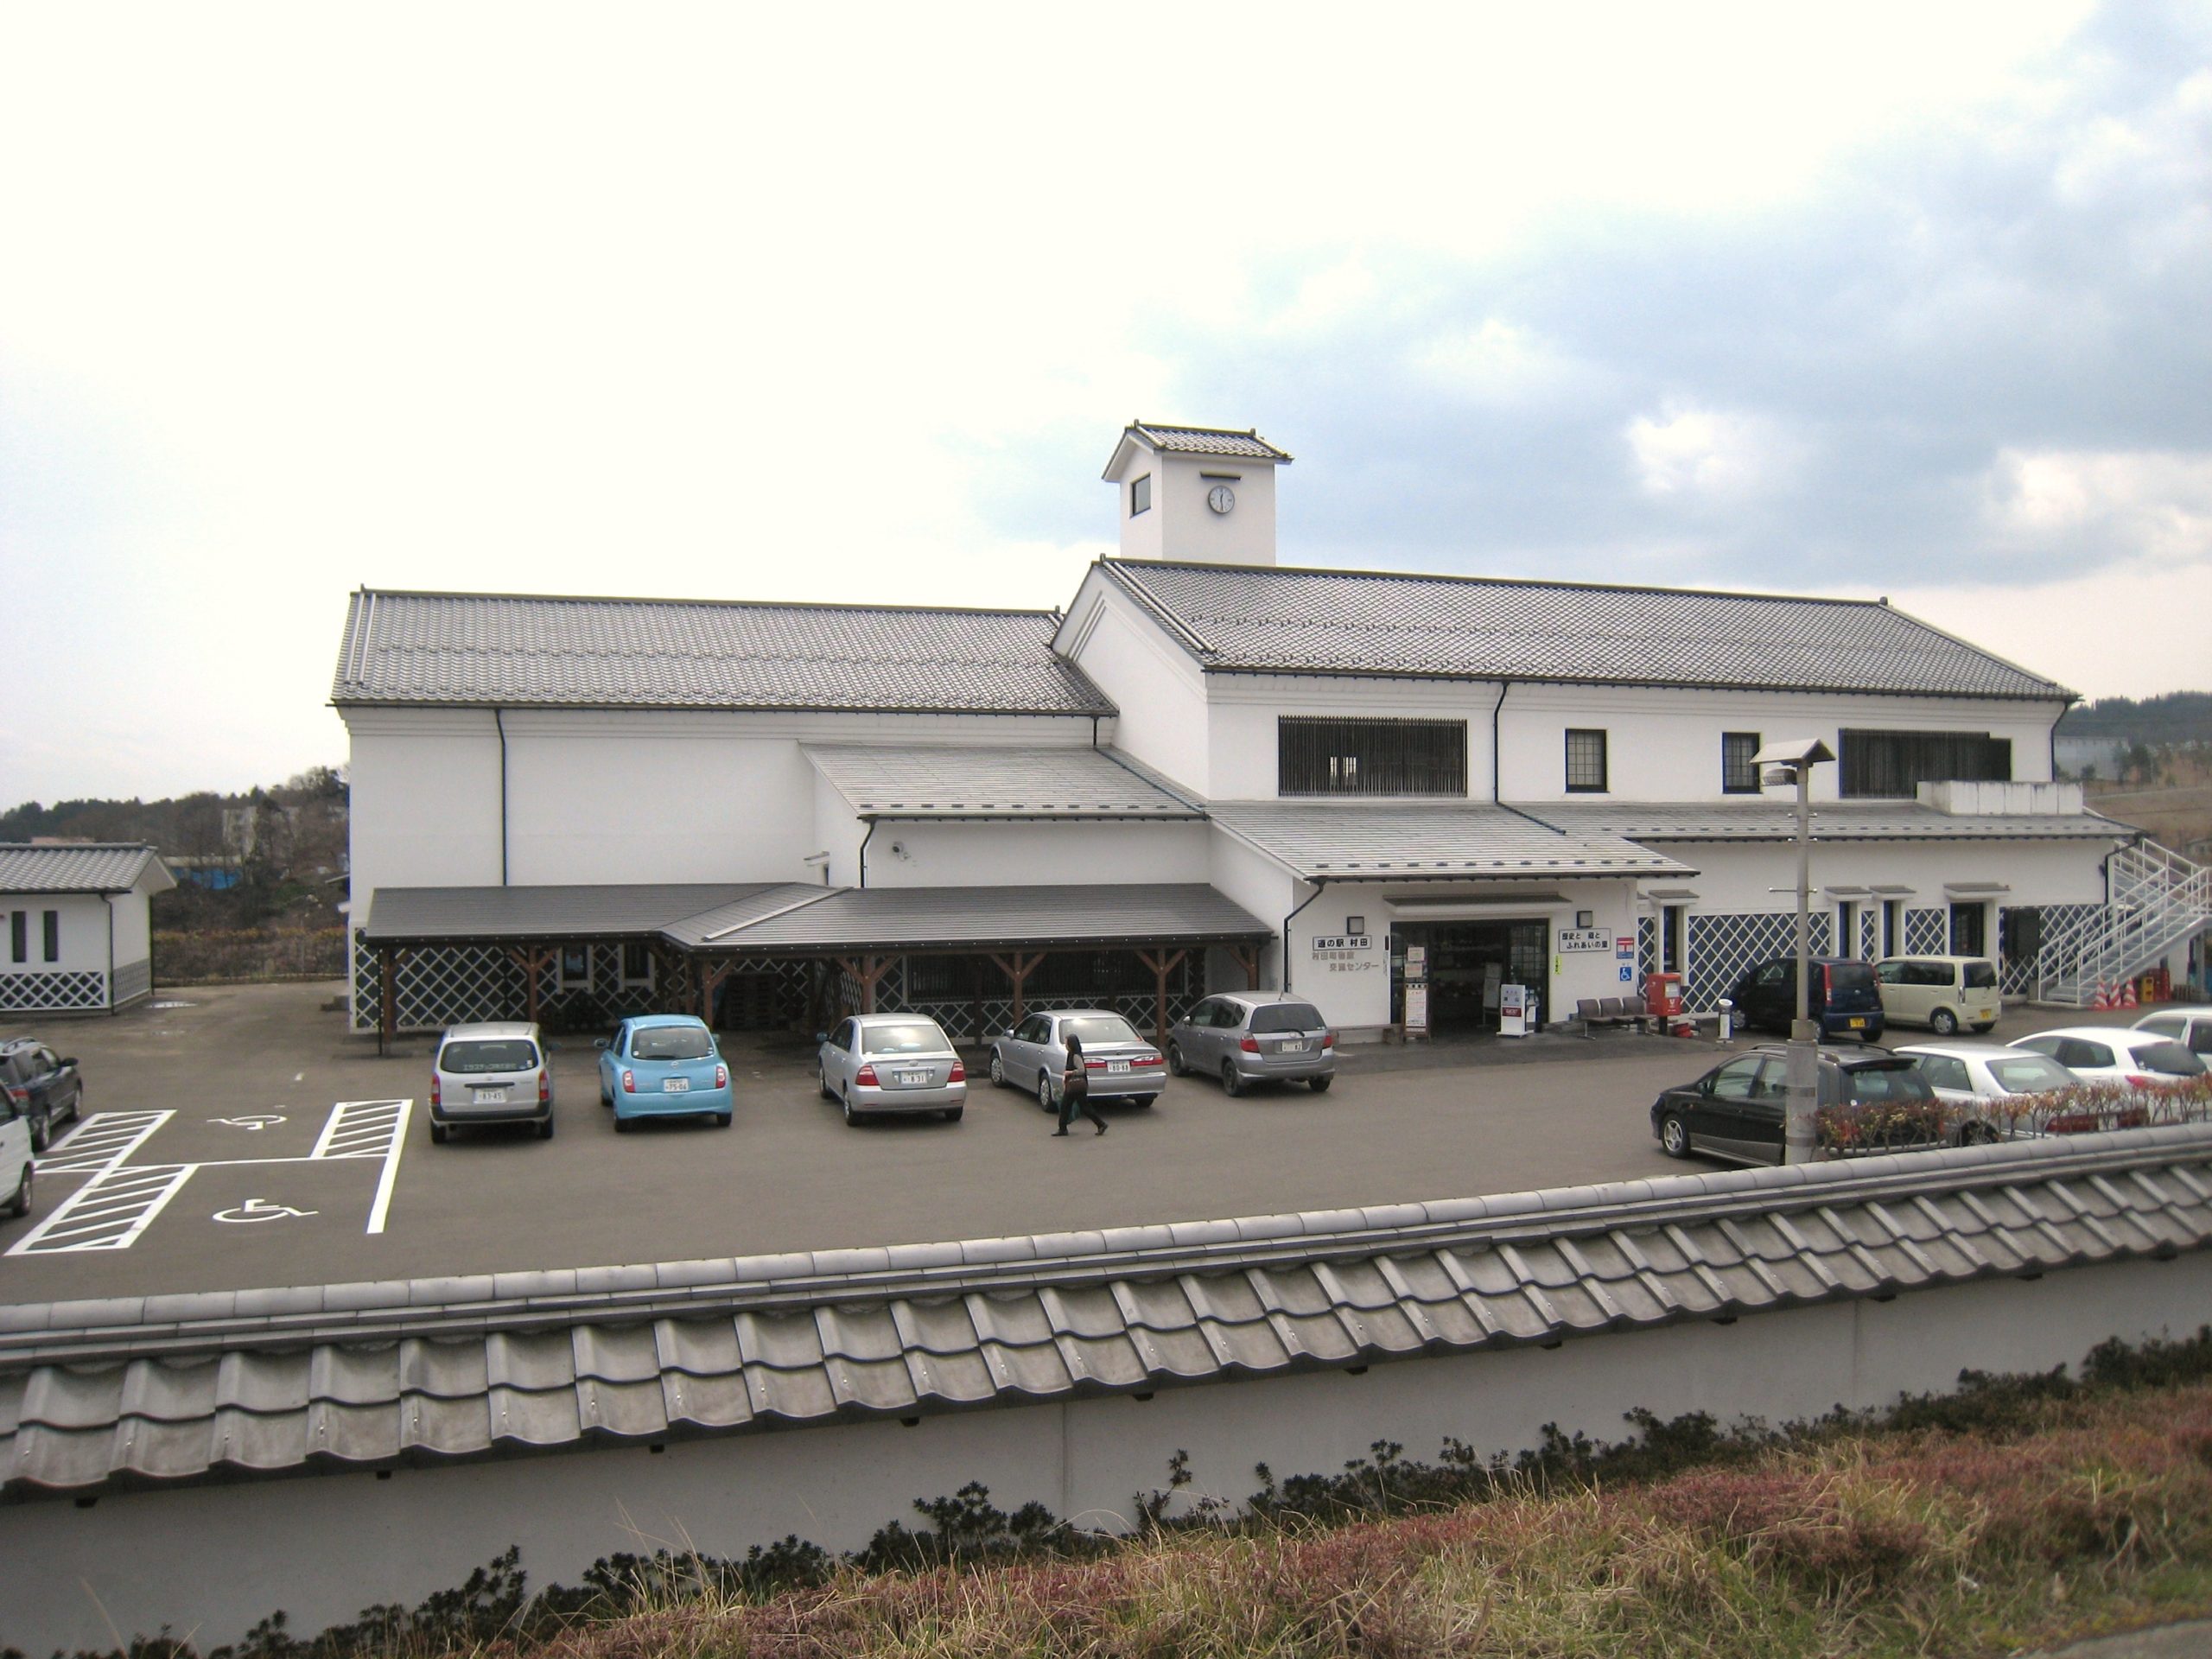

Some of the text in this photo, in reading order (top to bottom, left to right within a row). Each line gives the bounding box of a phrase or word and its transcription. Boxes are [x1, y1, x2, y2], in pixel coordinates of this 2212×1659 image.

[1318, 938, 1368, 948] 道の駅 村田
